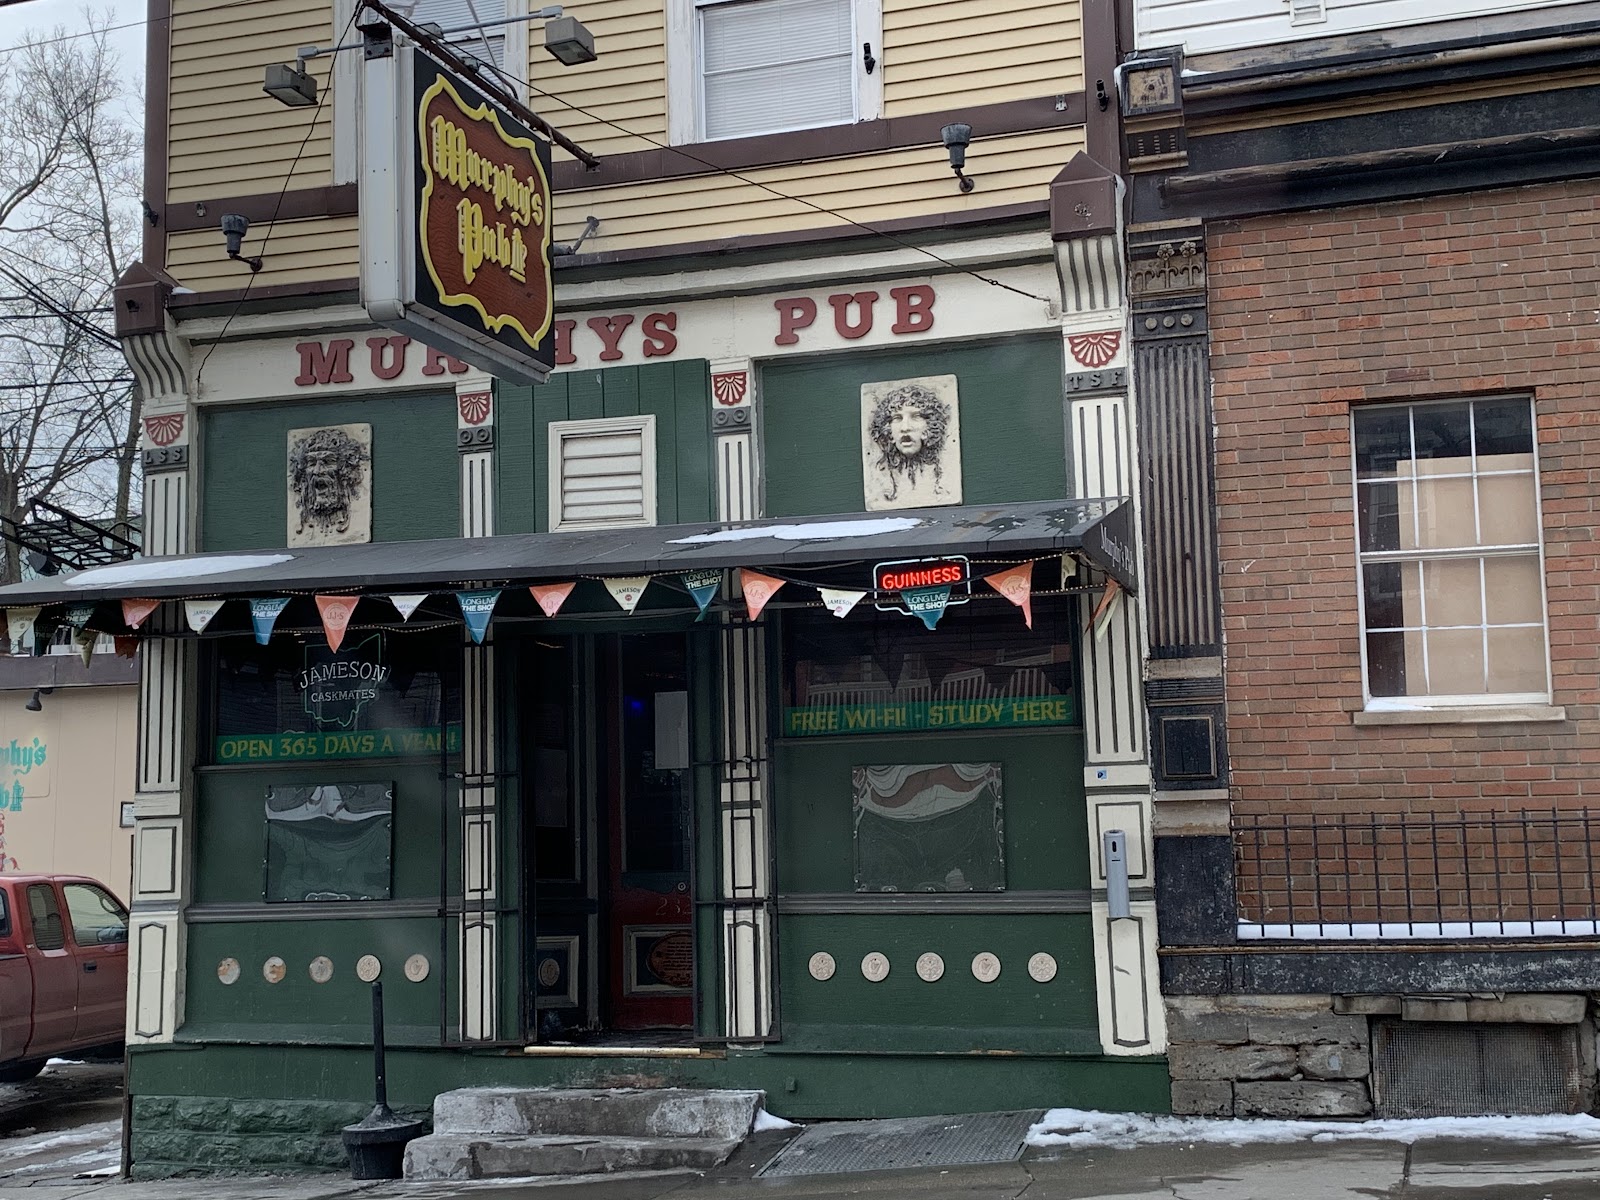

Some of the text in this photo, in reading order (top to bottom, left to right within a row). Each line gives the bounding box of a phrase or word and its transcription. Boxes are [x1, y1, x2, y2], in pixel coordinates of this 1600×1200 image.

[430, 114, 543, 226] Murphy's
[456, 197, 511, 285] Pub
[774, 284, 935, 346] PUB
[685, 569, 722, 582] LONG LIVE
[686, 576, 723, 589] THE SHOT
[882, 566, 962, 590] GUINNESS
[615, 587, 641, 595] JAMESON
[908, 593, 947, 604] LONG LIVE
[253, 603, 272, 611] LONG
[462, 598, 481, 606] LONG
[908, 600, 947, 611] THE SHOT
[300, 661, 387, 688] JAMESON
[311, 688, 376, 703] CASKMATES
[791, 710, 838, 732] FREE
[928, 703, 1005, 725] STUDY
[1013, 701, 1068, 721] HERE
[220, 738, 273, 758] OPEN
[280, 737, 318, 757] 365
[324, 734, 375, 754] DAYS
[381, 733, 395, 751] A
